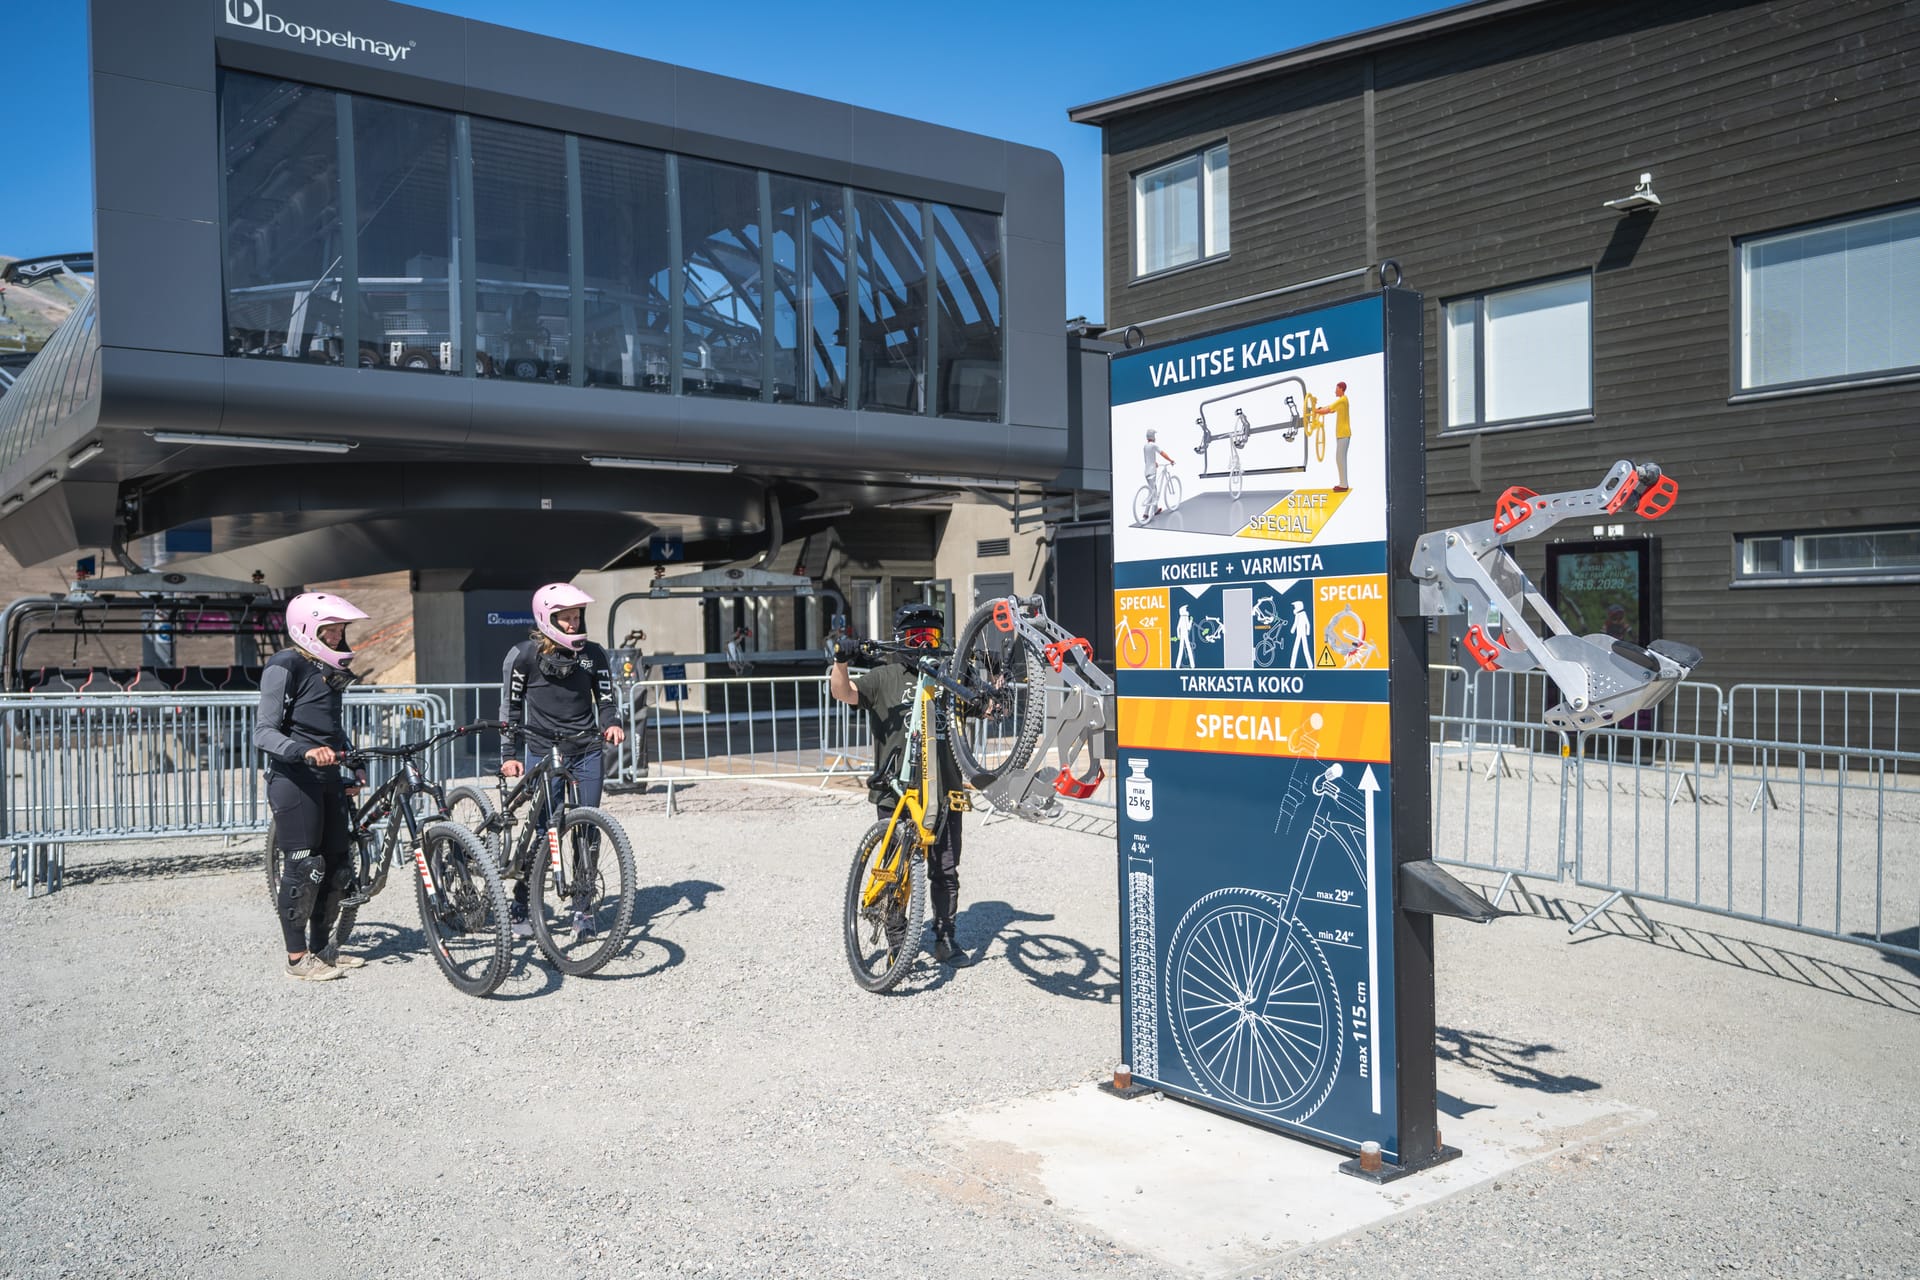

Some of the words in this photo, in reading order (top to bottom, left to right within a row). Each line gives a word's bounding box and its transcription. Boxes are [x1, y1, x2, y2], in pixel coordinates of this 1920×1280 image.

[265, 14, 411, 62] Doppelmayr
[1149, 347, 1235, 388] VALITSE
[1242, 326, 1329, 368] KAISTA
[1287, 494, 1328, 509] STAFF
[1250, 515, 1312, 534] SPECIAL
[1161, 561, 1218, 581] KOKEILE
[1241, 554, 1324, 575] VARMISTA
[1120, 595, 1166, 611] SPECIAL
[1320, 583, 1383, 602] SPECIAL
[511, 669, 526, 701] FOX
[597, 669, 613, 702] FOX
[1180, 676, 1254, 693] TARKASTA
[1257, 676, 1304, 693] KOKO
[1195, 714, 1288, 742] SPECIAL
[1129, 796, 1138, 806] 25
[1140, 797, 1150, 811] kg
[1316, 890, 1333, 900] max
[1318, 930, 1333, 940] min
[1357, 981, 1367, 1004] cm
[1352, 1006, 1367, 1041] 115
[1359, 1045, 1368, 1078] max
